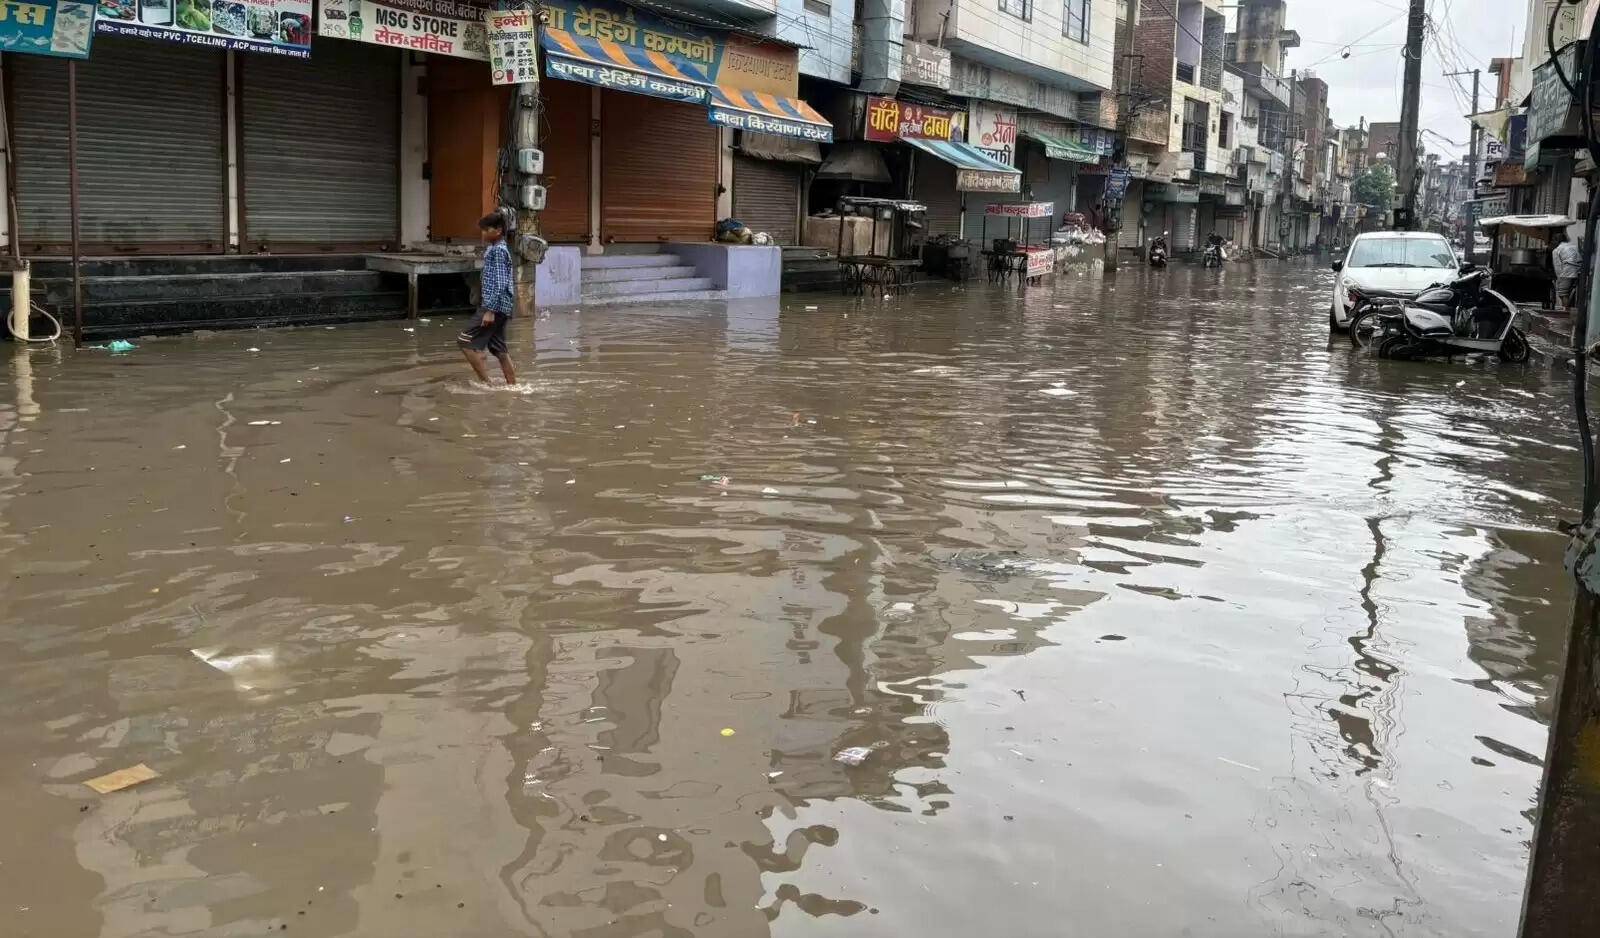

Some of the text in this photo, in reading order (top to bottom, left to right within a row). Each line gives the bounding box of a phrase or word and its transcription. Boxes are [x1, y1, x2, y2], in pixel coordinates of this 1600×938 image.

[376, 8, 458, 37] MSG STORE
[162, 32, 181, 41] PVC
[232, 41, 250, 50] ACP
[375, 26, 404, 44] सेल
[551, 61, 595, 79] बाबा
[650, 80, 706, 99] कम्पनी
[714, 112, 744, 127] बाबा
[870, 101, 899, 133] चाँदी
[923, 115, 949, 138] ढाबा
